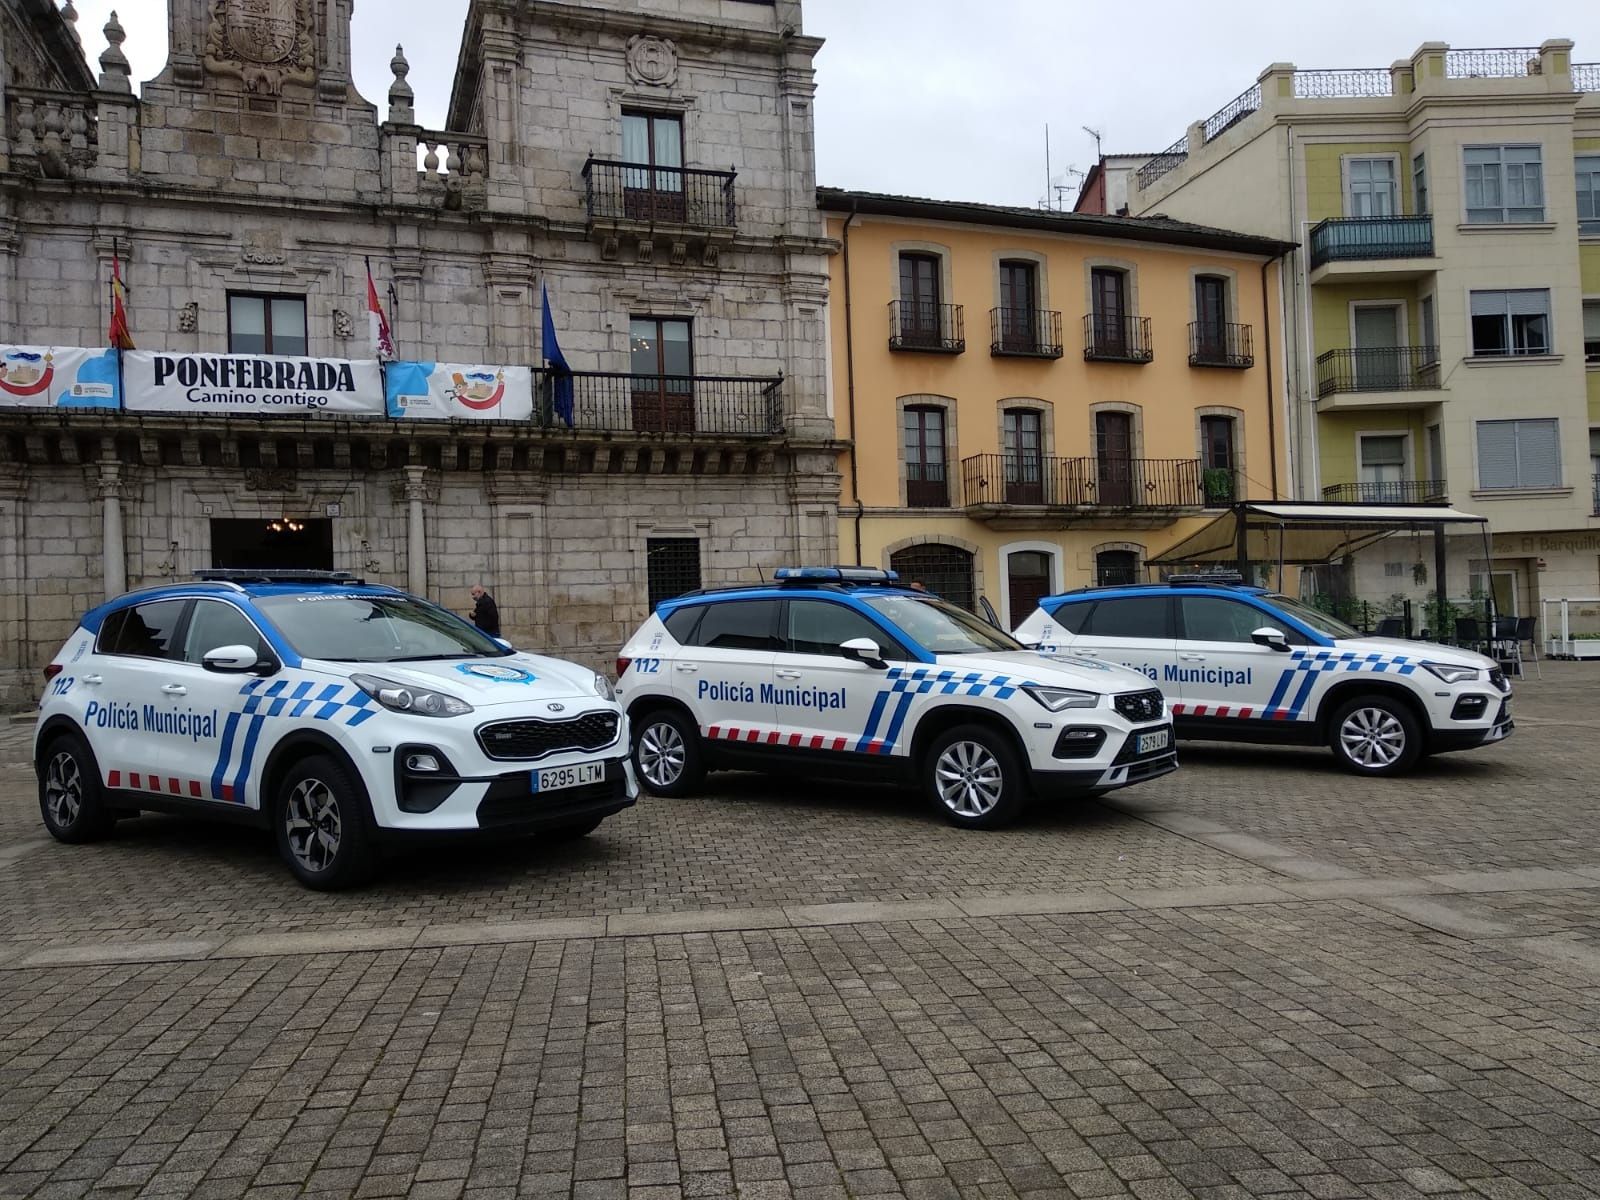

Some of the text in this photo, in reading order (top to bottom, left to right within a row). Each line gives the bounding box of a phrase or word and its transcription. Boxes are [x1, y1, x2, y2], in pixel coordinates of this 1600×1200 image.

[154, 357, 356, 391] PONFERRADA
[187, 388, 328, 409] Camino contigo
[634, 658, 660, 673] 112
[1164, 664, 1252, 687] Municipal
[51, 677, 75, 695] 112
[699, 680, 846, 712] Policía Municipal
[84, 701, 217, 742] Policía Municipal
[1141, 735, 1155, 751] 2579
[541, 764, 602, 788] 6295 LTM
